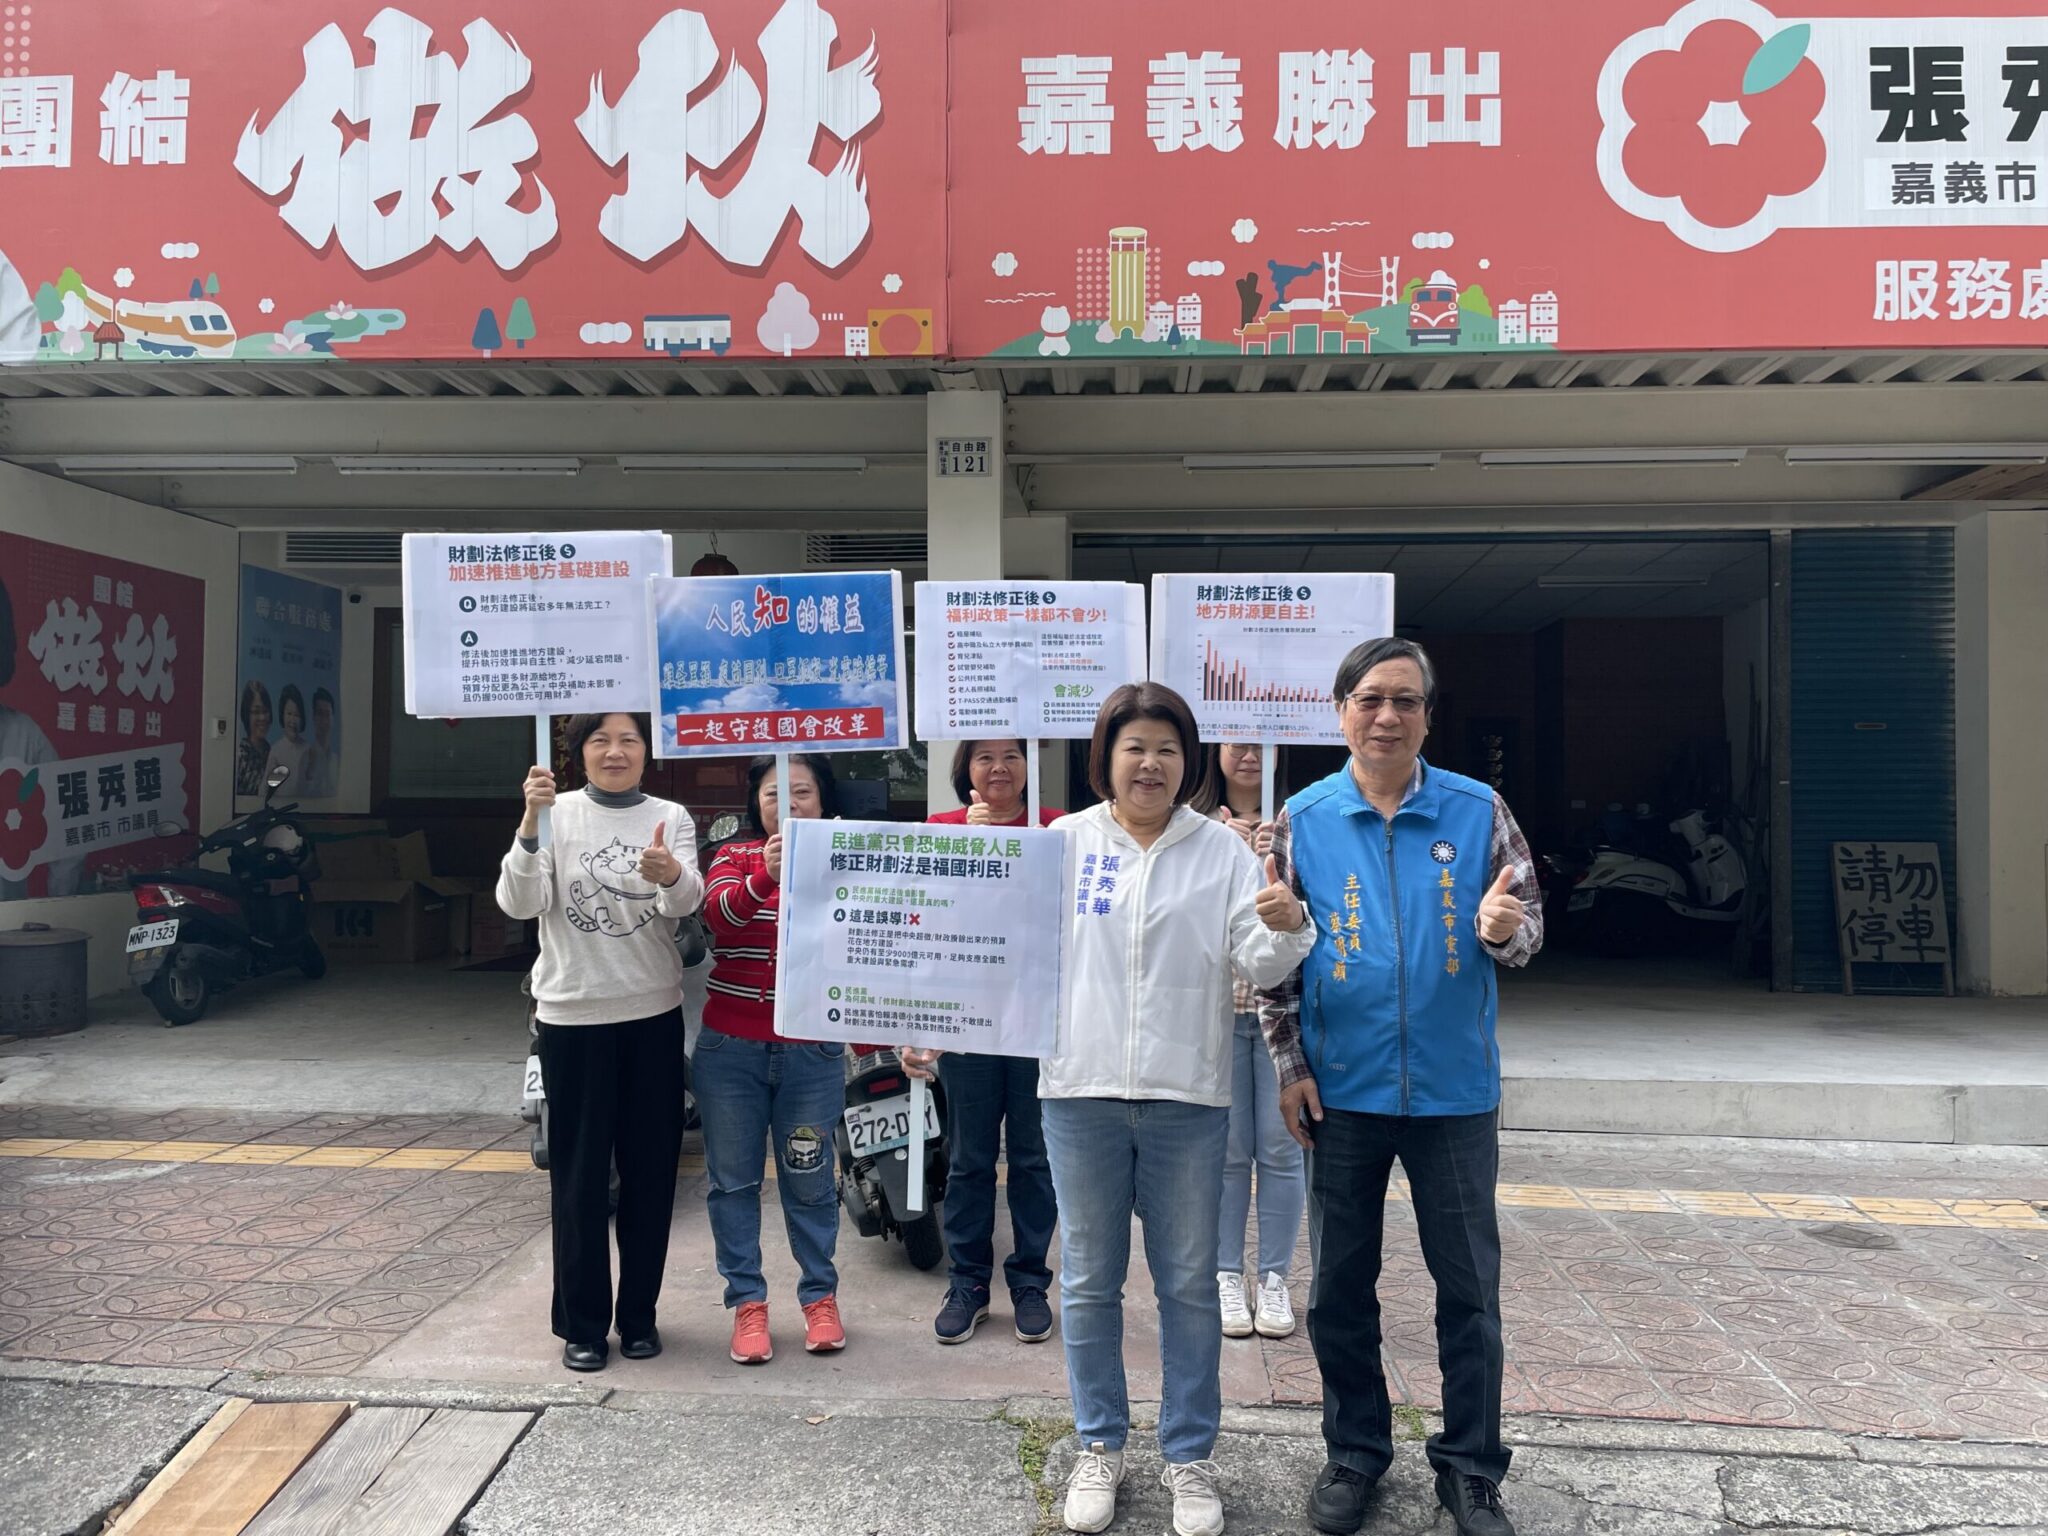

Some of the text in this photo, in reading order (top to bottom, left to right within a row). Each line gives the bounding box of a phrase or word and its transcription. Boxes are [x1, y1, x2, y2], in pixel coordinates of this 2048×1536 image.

[1017, 47, 1502, 154] 嘉義勝出
[1891, 160, 2037, 205] 嘉義市
[952, 442, 986, 452] 自由路
[953, 456, 985, 472] 121
[448, 545, 556, 563] 財劃法修正後
[449, 561, 630, 581] 加速推進地方基礎建設
[946, 591, 1040, 606] 財劃法修正後
[1197, 585, 1293, 601] 財劃法修正後
[706, 584, 864, 637] 人民知的權益
[946, 608, 1107, 623] 福利政策一樣都不會少!
[1196, 603, 1315, 620] 地方財源更自主!
[1053, 683, 1094, 698] 會減少
[57, 702, 162, 738] 嘉義勝出
[680, 713, 869, 741] 一起守護國會改革
[57, 757, 162, 820] 張秀華
[831, 832, 1023, 857] 民進黨只會恐嚇威脅人民
[830, 853, 1010, 878] 修正財劃法是福國利民!
[1839, 843, 1938, 904] 請勿
[1076, 854, 1097, 915] 嘉義市議員
[1092, 855, 1120, 916] 張秀華
[849, 909, 907, 925] 這是誤導!
[1343, 873, 1362, 951] 主任委員
[1842, 903, 1946, 962] 停車
[851, 1105, 932, 1149] 272-DY
